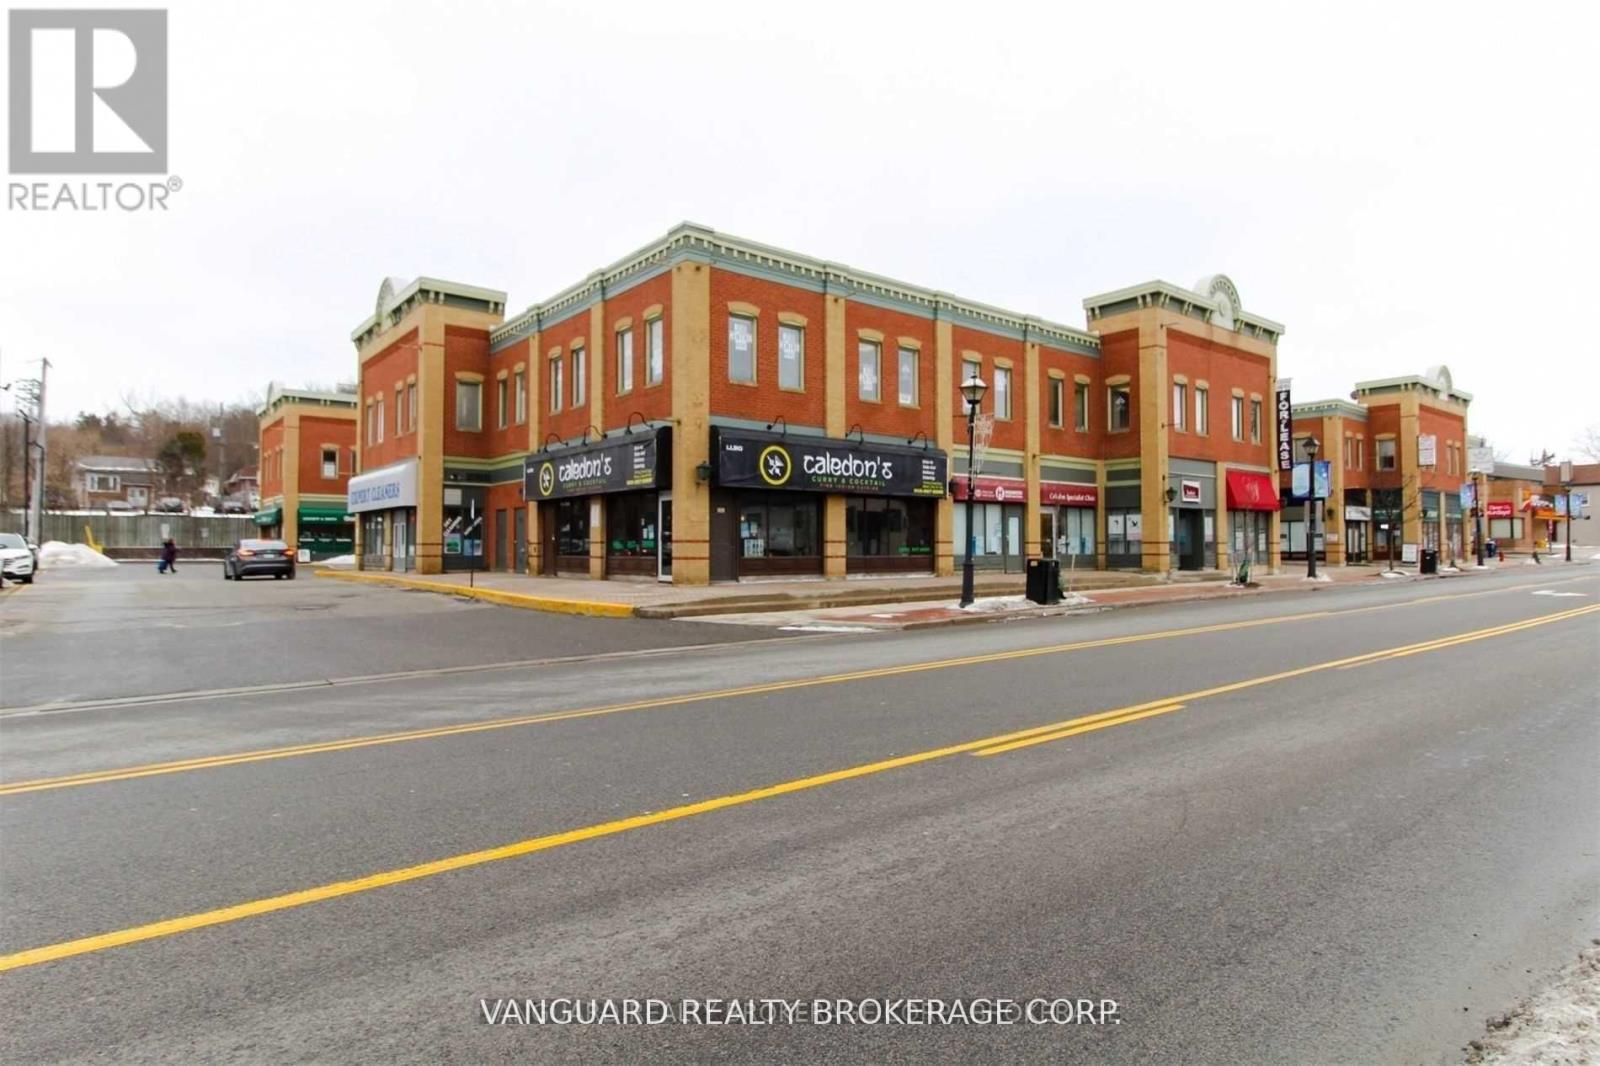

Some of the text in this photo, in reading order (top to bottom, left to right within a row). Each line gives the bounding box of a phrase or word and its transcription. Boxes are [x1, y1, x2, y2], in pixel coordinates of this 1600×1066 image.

[803, 451, 893, 480] caledon's
[811, 475, 838, 483] CURRY
[849, 478, 886, 487] COCKTAIL
